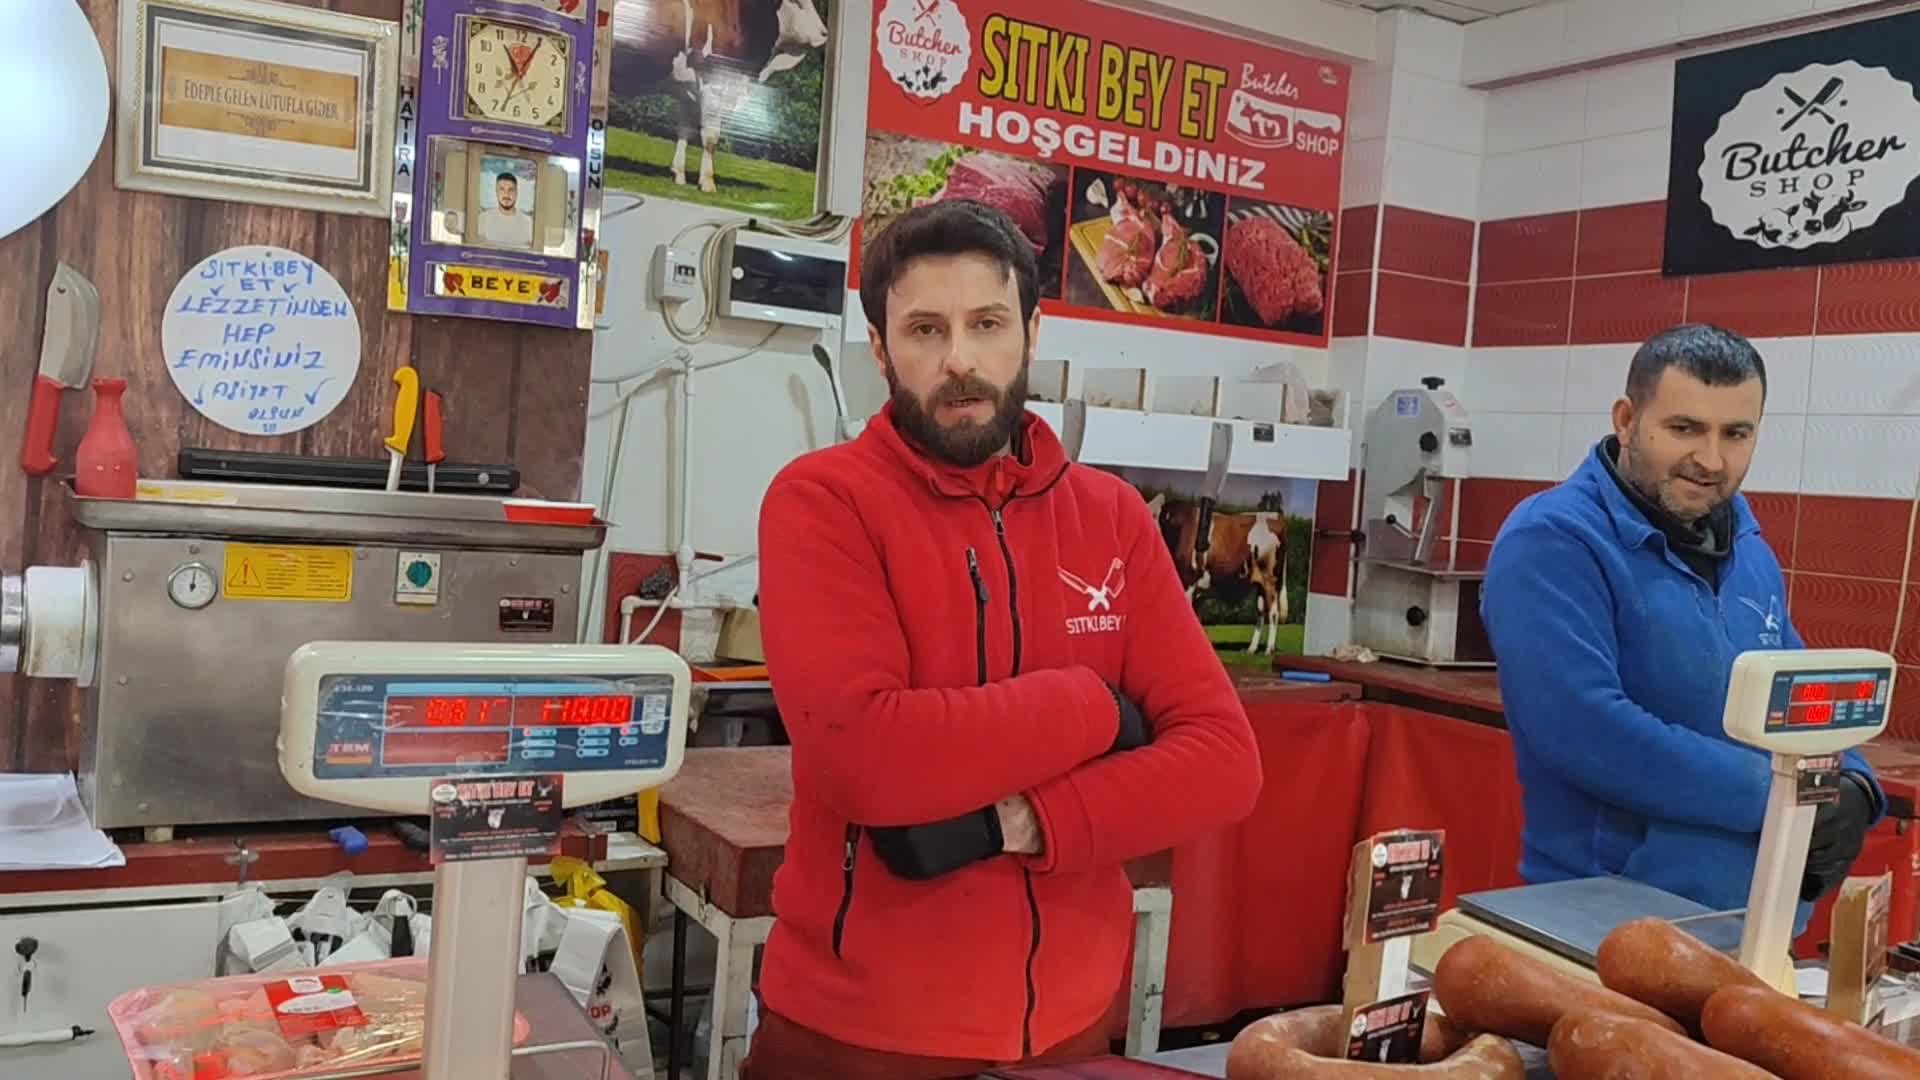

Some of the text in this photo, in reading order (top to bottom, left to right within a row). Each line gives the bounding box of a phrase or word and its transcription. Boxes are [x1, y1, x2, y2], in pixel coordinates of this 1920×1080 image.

[887, 20, 962, 55] Butcher
[978, 13, 1229, 142] SITKI BEY ET
[1240, 62, 1300, 101] Butcher
[398, 85, 414, 177] HATIRA
[1295, 131, 1340, 157] SHOP
[588, 119, 604, 189] OLSUN
[1721, 123, 1906, 181] Butcher
[1749, 168, 1865, 198] SHOP
[239, 278, 275, 291] ET
[471, 276, 531, 293] BEYE
[222, 323, 276, 344] HEP
